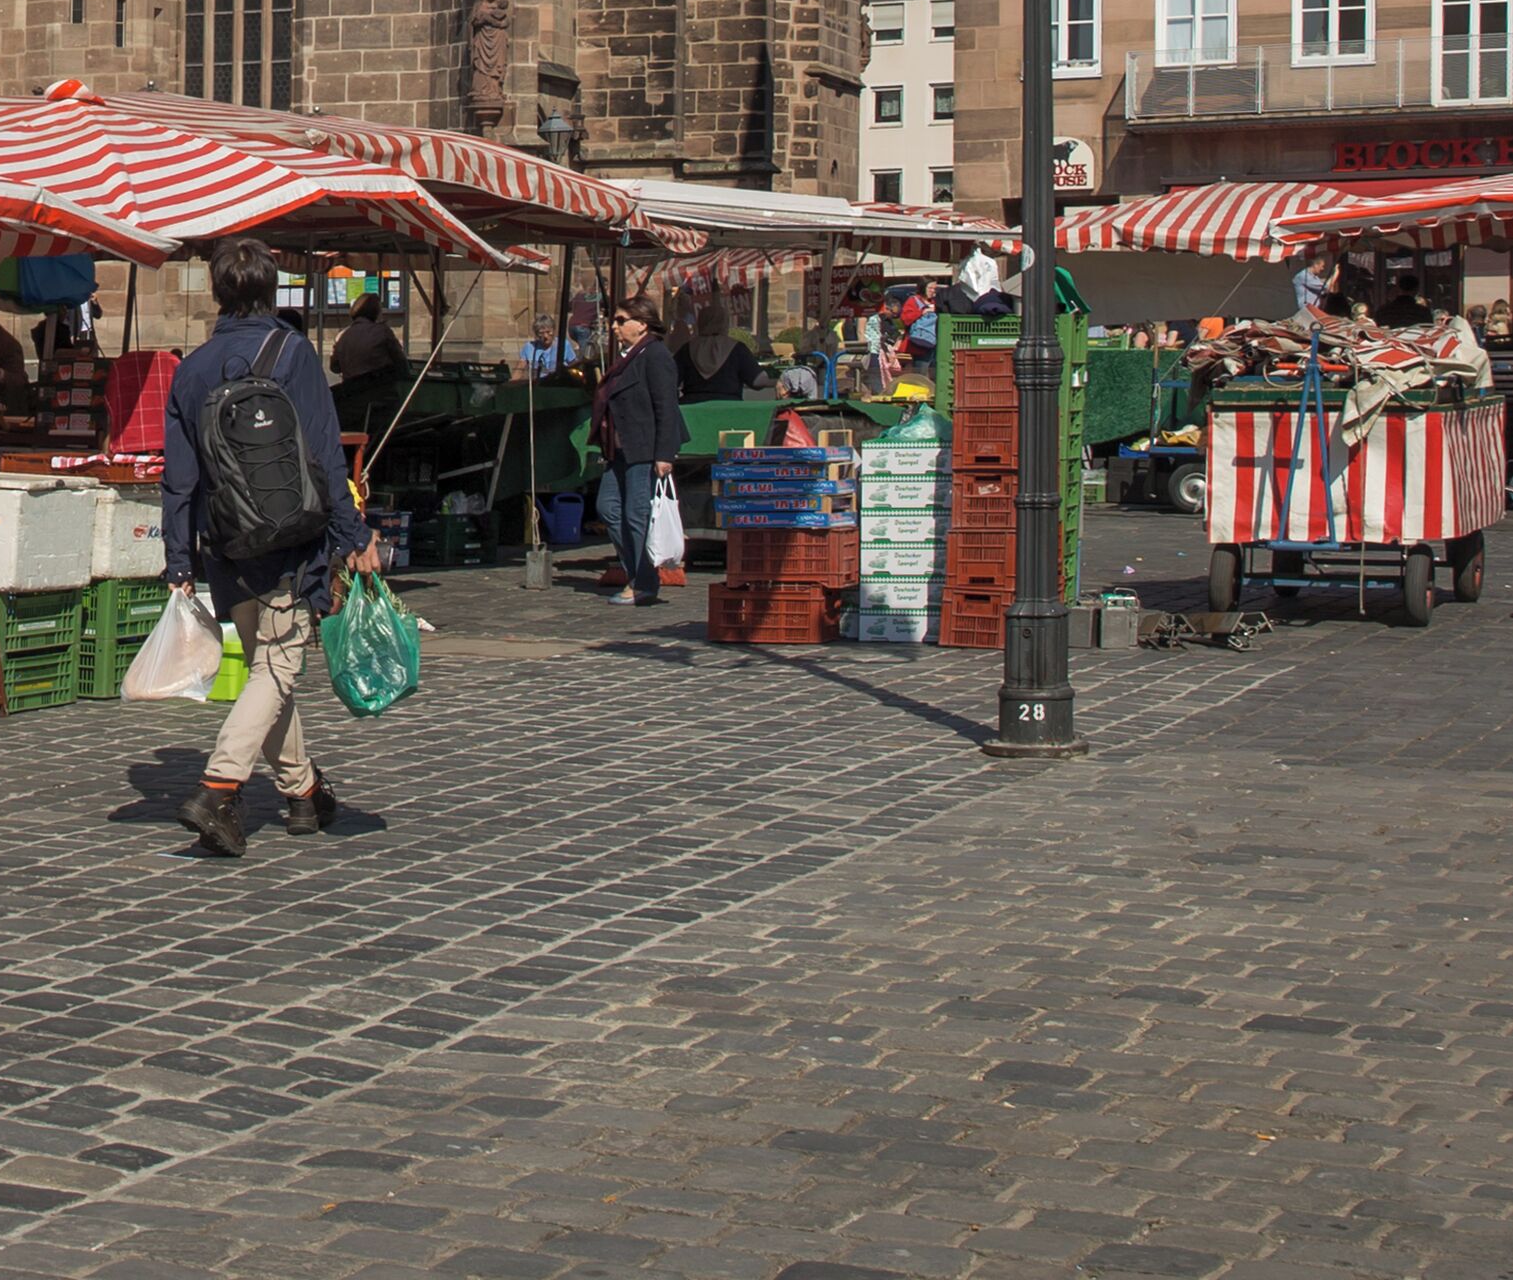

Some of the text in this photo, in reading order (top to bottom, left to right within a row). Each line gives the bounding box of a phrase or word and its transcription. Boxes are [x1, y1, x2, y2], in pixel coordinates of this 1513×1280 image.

[1331, 138, 1483, 172] BLOCK
[1054, 163, 1087, 176] OCK
[1054, 175, 1087, 187] USE
[1019, 704, 1045, 721] 28
